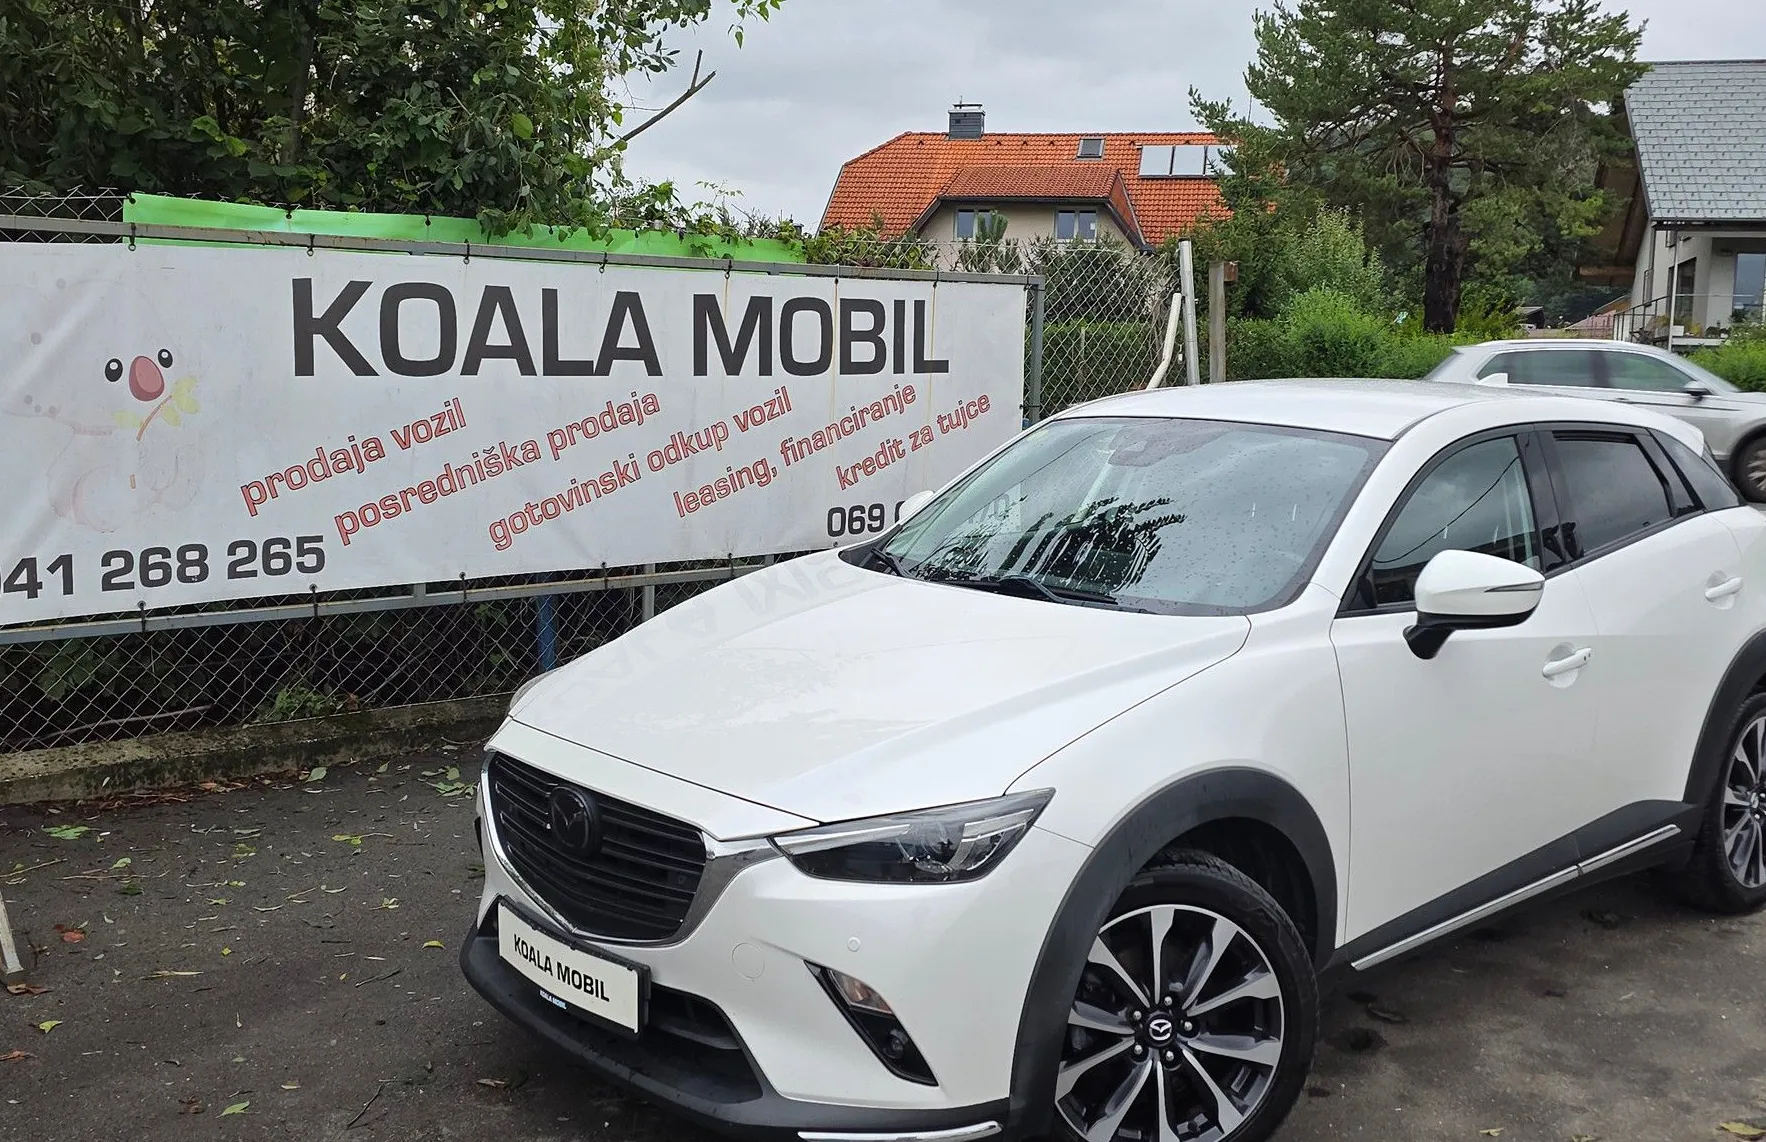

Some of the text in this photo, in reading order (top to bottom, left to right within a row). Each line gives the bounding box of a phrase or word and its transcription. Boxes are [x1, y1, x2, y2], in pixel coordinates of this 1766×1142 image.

[292, 278, 949, 377] KOALA MOBIL
[240, 398, 467, 516] prodaja vozil
[334, 391, 661, 546] posredniška prodaja
[488, 386, 793, 551] gotovinski odkup vozil
[673, 381, 917, 518] leasing, financiranje
[836, 391, 991, 491] kredit za tujce
[0, 535, 325, 599] 41 268 265
[827, 503, 885, 537] 069
[514, 933, 610, 1002] KOALA MOBIL
